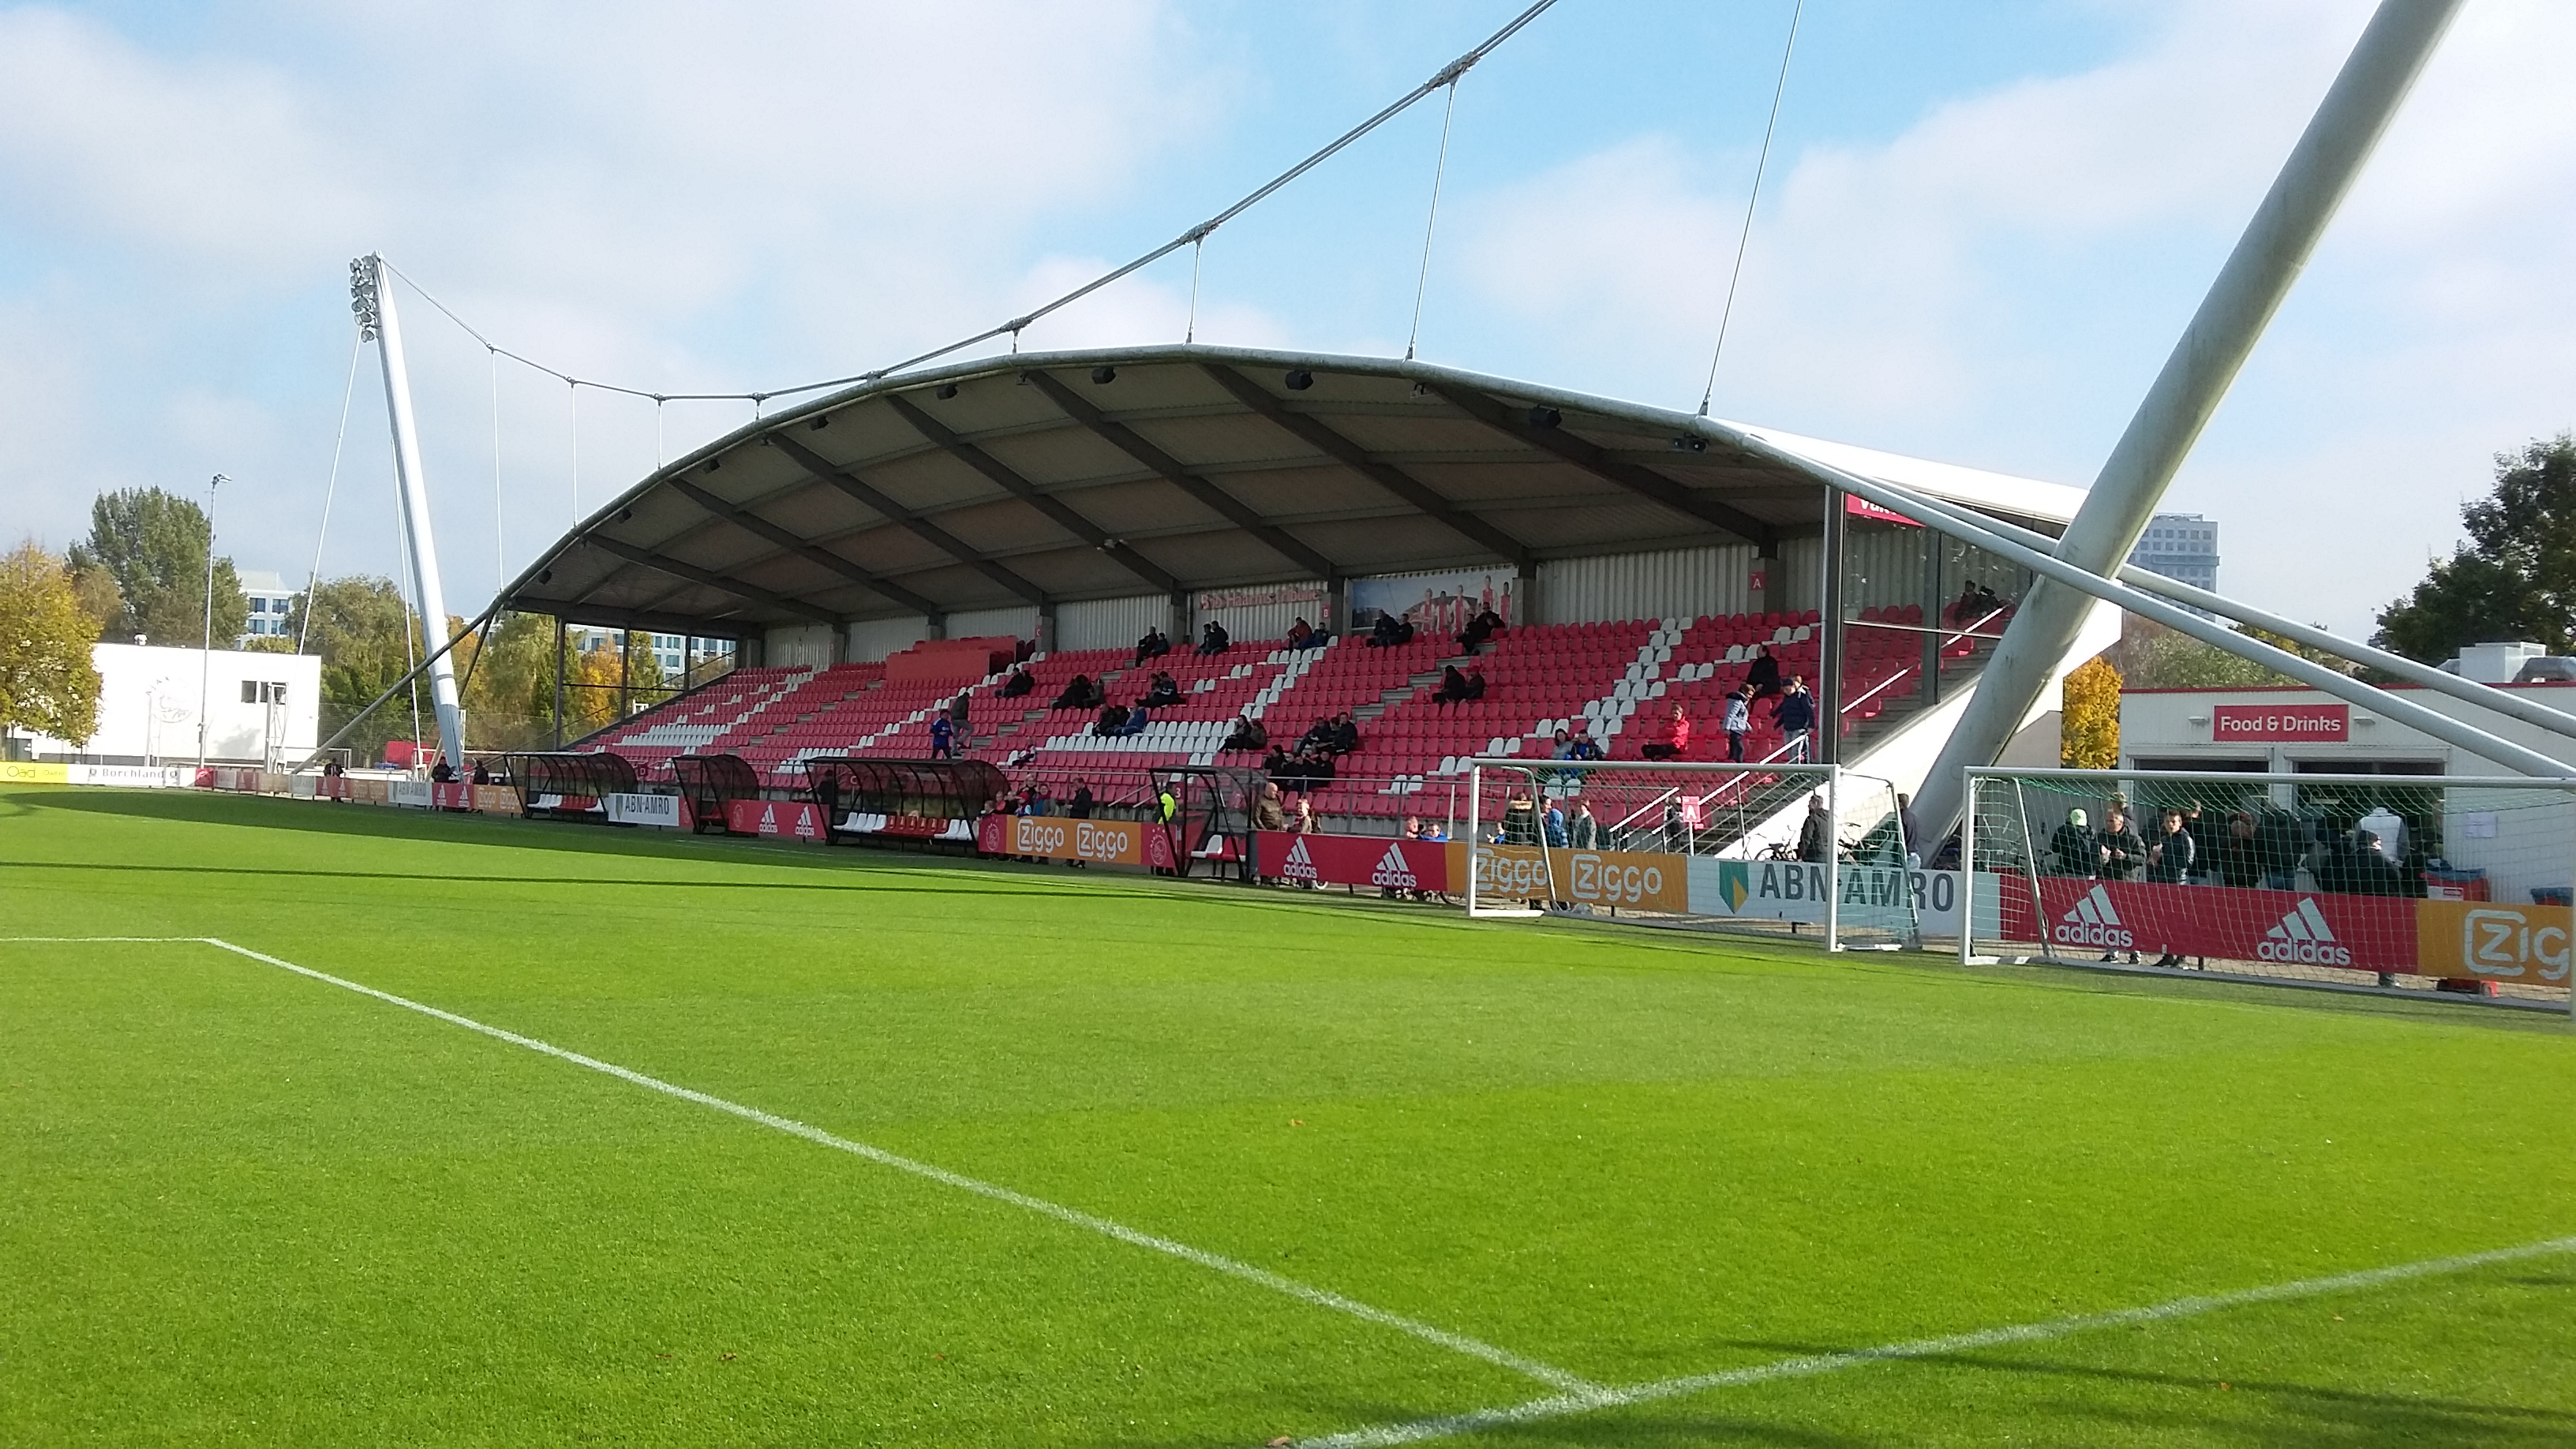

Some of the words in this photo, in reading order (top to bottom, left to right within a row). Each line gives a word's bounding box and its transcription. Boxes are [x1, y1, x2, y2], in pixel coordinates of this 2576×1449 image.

[1753, 578, 1761, 589] A
[2221, 716, 2263, 732] Food
[2267, 716, 2279, 732] &
[2283, 715, 2341, 732] Drinks
[6, 766, 36, 778] Oad
[102, 768, 164, 779] Borchland
[625, 796, 642, 813] ABN
[645, 797, 670, 815] AMRO
[1686, 804, 1697, 820] A
[1283, 863, 1317, 879] adidas
[1372, 870, 1417, 888] adidas
[1844, 867, 1955, 912] AMRO
[2055, 921, 2133, 948] adidas
[2257, 938, 2351, 966] adidas
